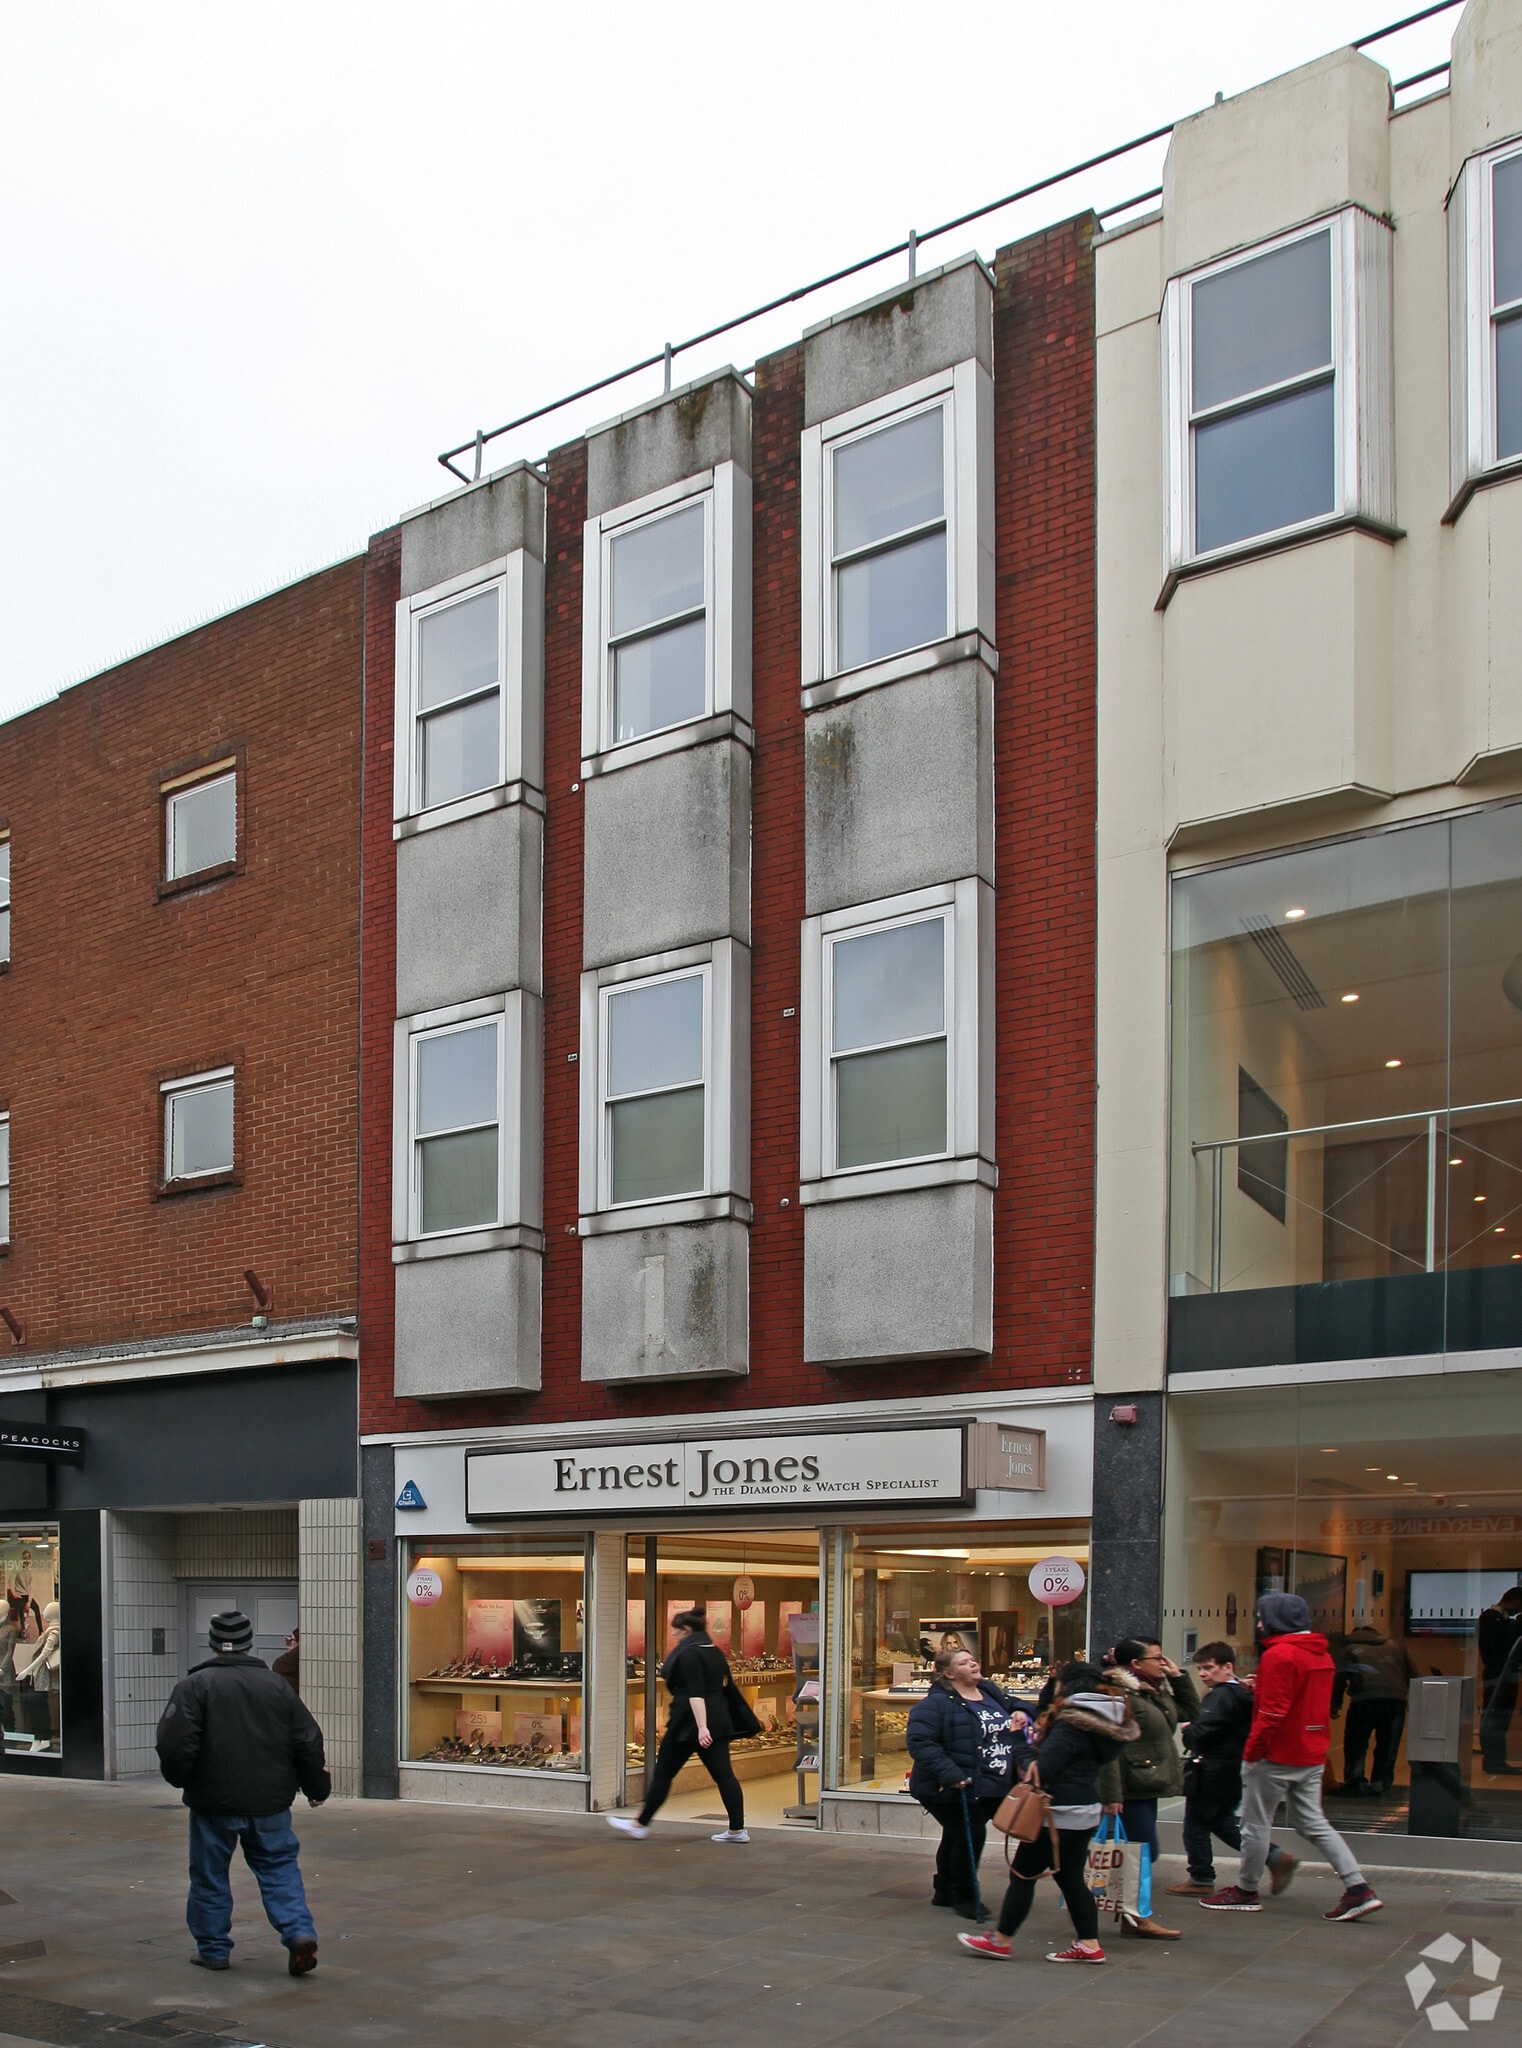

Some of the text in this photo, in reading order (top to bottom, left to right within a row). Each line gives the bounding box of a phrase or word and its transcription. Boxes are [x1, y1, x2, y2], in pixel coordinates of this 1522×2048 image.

[1, 1434, 80, 1448] PEACOCKS
[1001, 1434, 1032, 1455] Ernest
[553, 1449, 820, 1498] Ernest Jones
[1006, 1456, 1033, 1478] Jones
[740, 1484, 798, 1495] DIAMOND
[802, 1484, 811, 1493] &
[815, 1481, 860, 1492] WATCH
[866, 1479, 939, 1490] SPECIALIST
[415, 1584, 433, 1597] 0%
[1043, 1577, 1070, 1592] 0%
